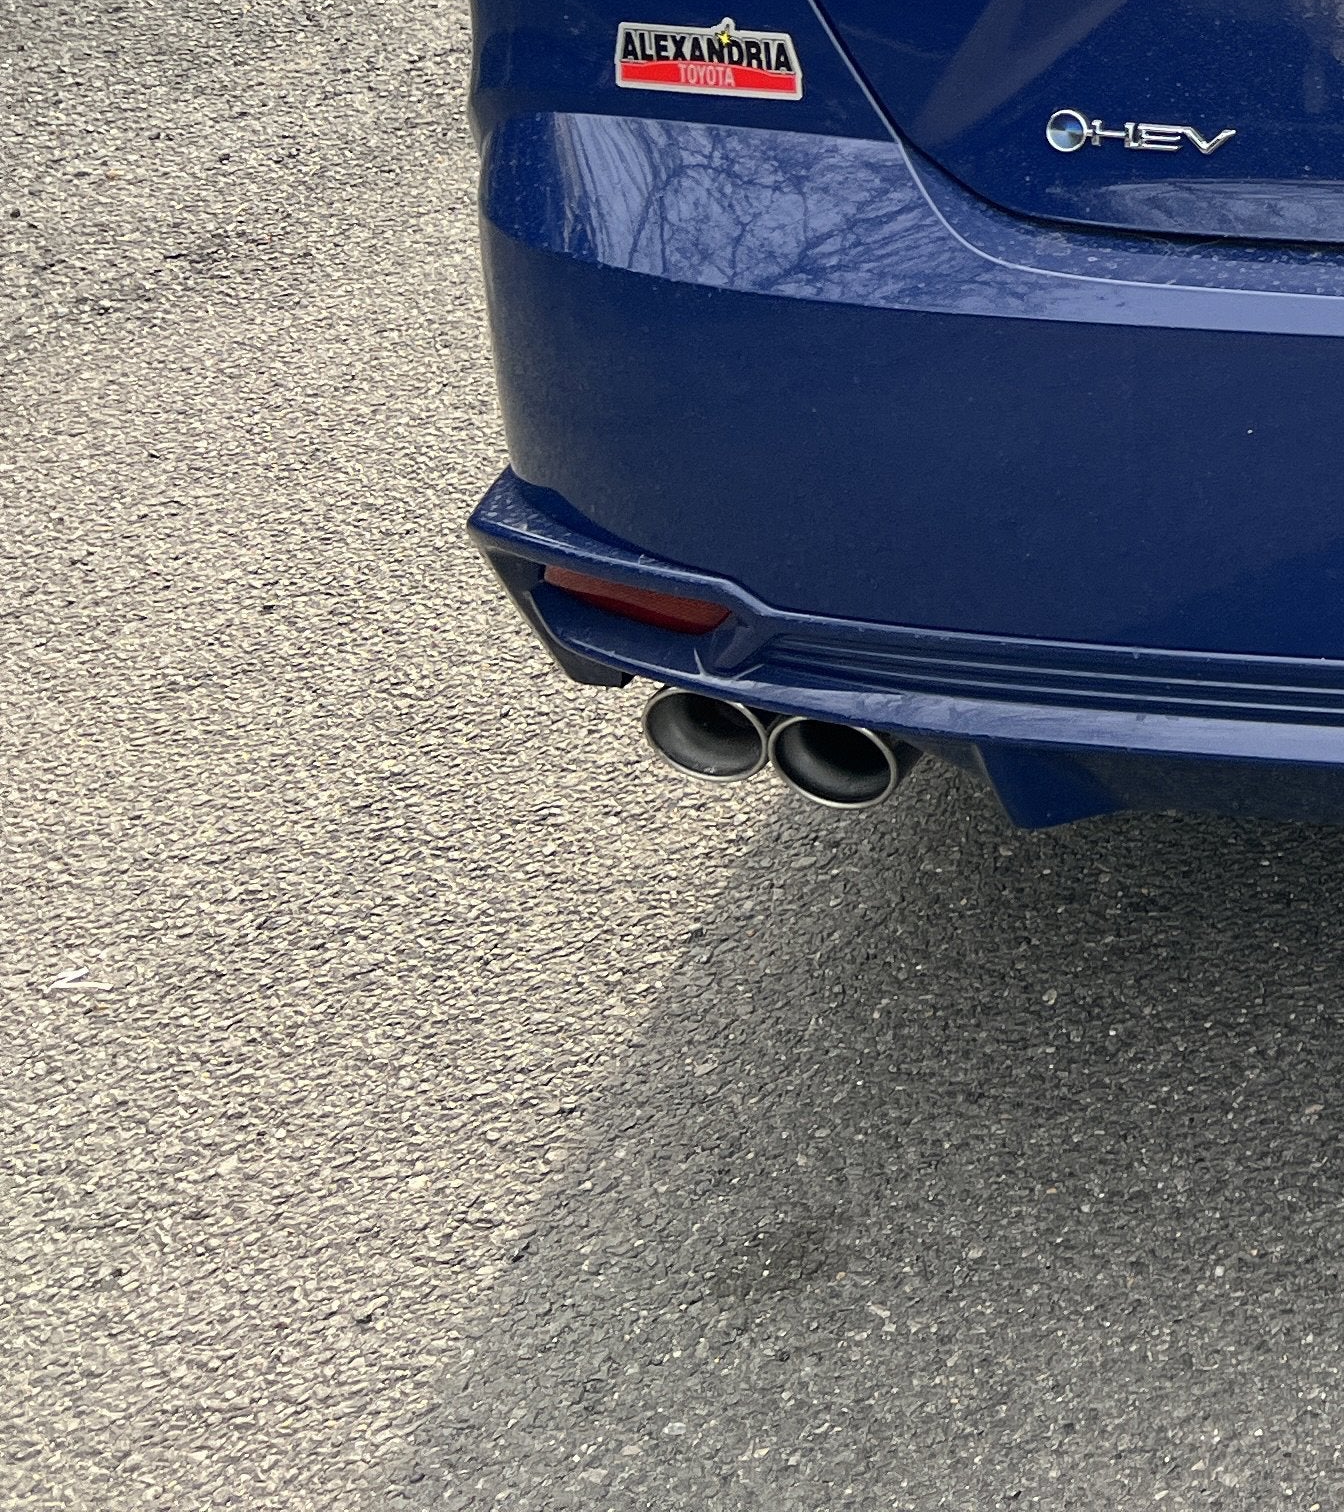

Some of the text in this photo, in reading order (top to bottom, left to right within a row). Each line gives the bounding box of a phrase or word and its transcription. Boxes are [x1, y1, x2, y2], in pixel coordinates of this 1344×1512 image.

[622, 30, 793, 73] ALEXANDRIA
[677, 63, 736, 87] TOYOTA
[1091, 118, 1237, 155] HEV
